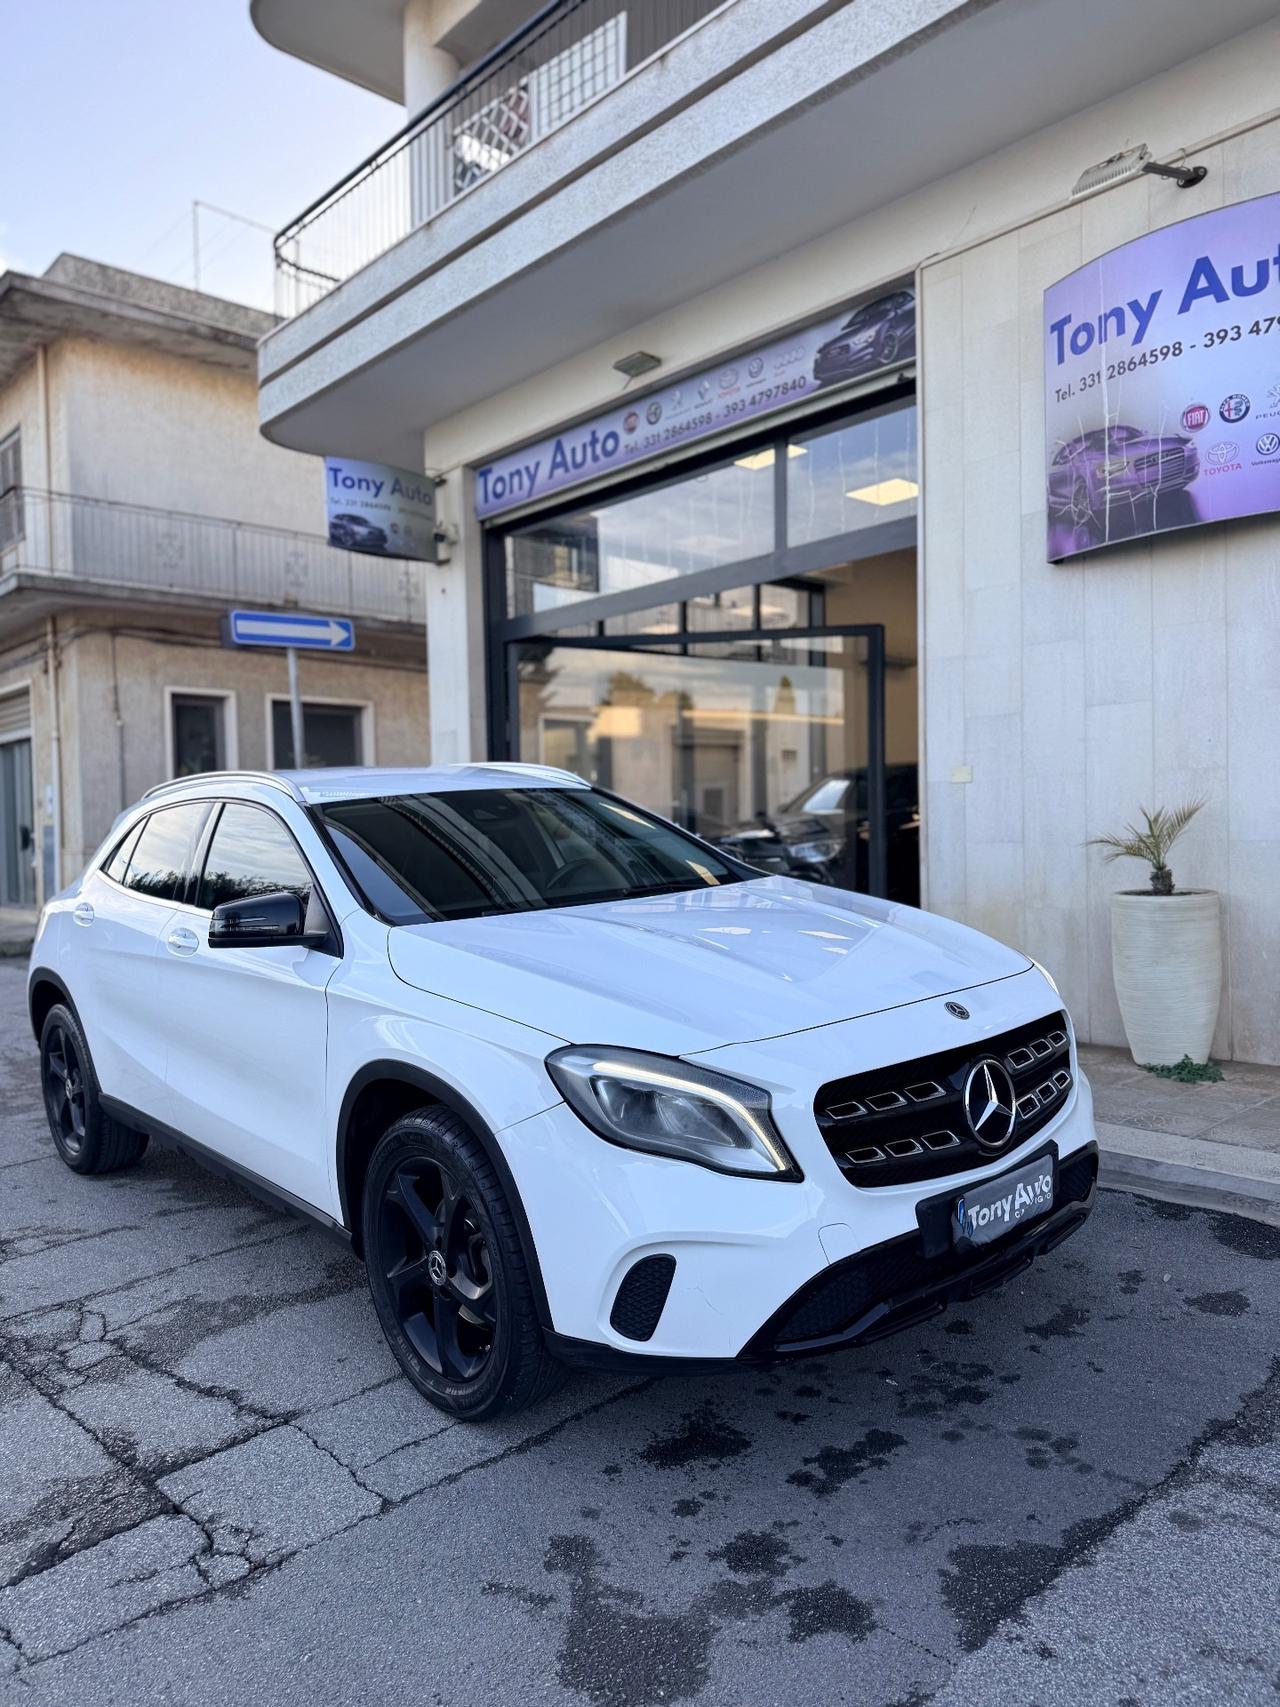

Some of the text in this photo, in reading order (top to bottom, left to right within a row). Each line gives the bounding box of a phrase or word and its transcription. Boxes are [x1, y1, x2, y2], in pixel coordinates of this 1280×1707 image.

[1050, 289, 1163, 365] Tony
[1055, 384, 1075, 403] Tel.
[1079, 370, 1102, 392] 331
[1106, 341, 1183, 381] 2864598
[1203, 325, 1242, 349] 393
[1248, 316, 1280, 336] 47
[643, 432, 661, 449] 331
[724, 399, 746, 419] 393
[750, 375, 807, 406] 4797840
[1187, 410, 1205, 427] FIAT
[328, 467, 385, 498] Tony
[390, 476, 433, 506] Auto
[479, 430, 620, 503] Tony Auto
[1203, 463, 1242, 476] TOYOTA
